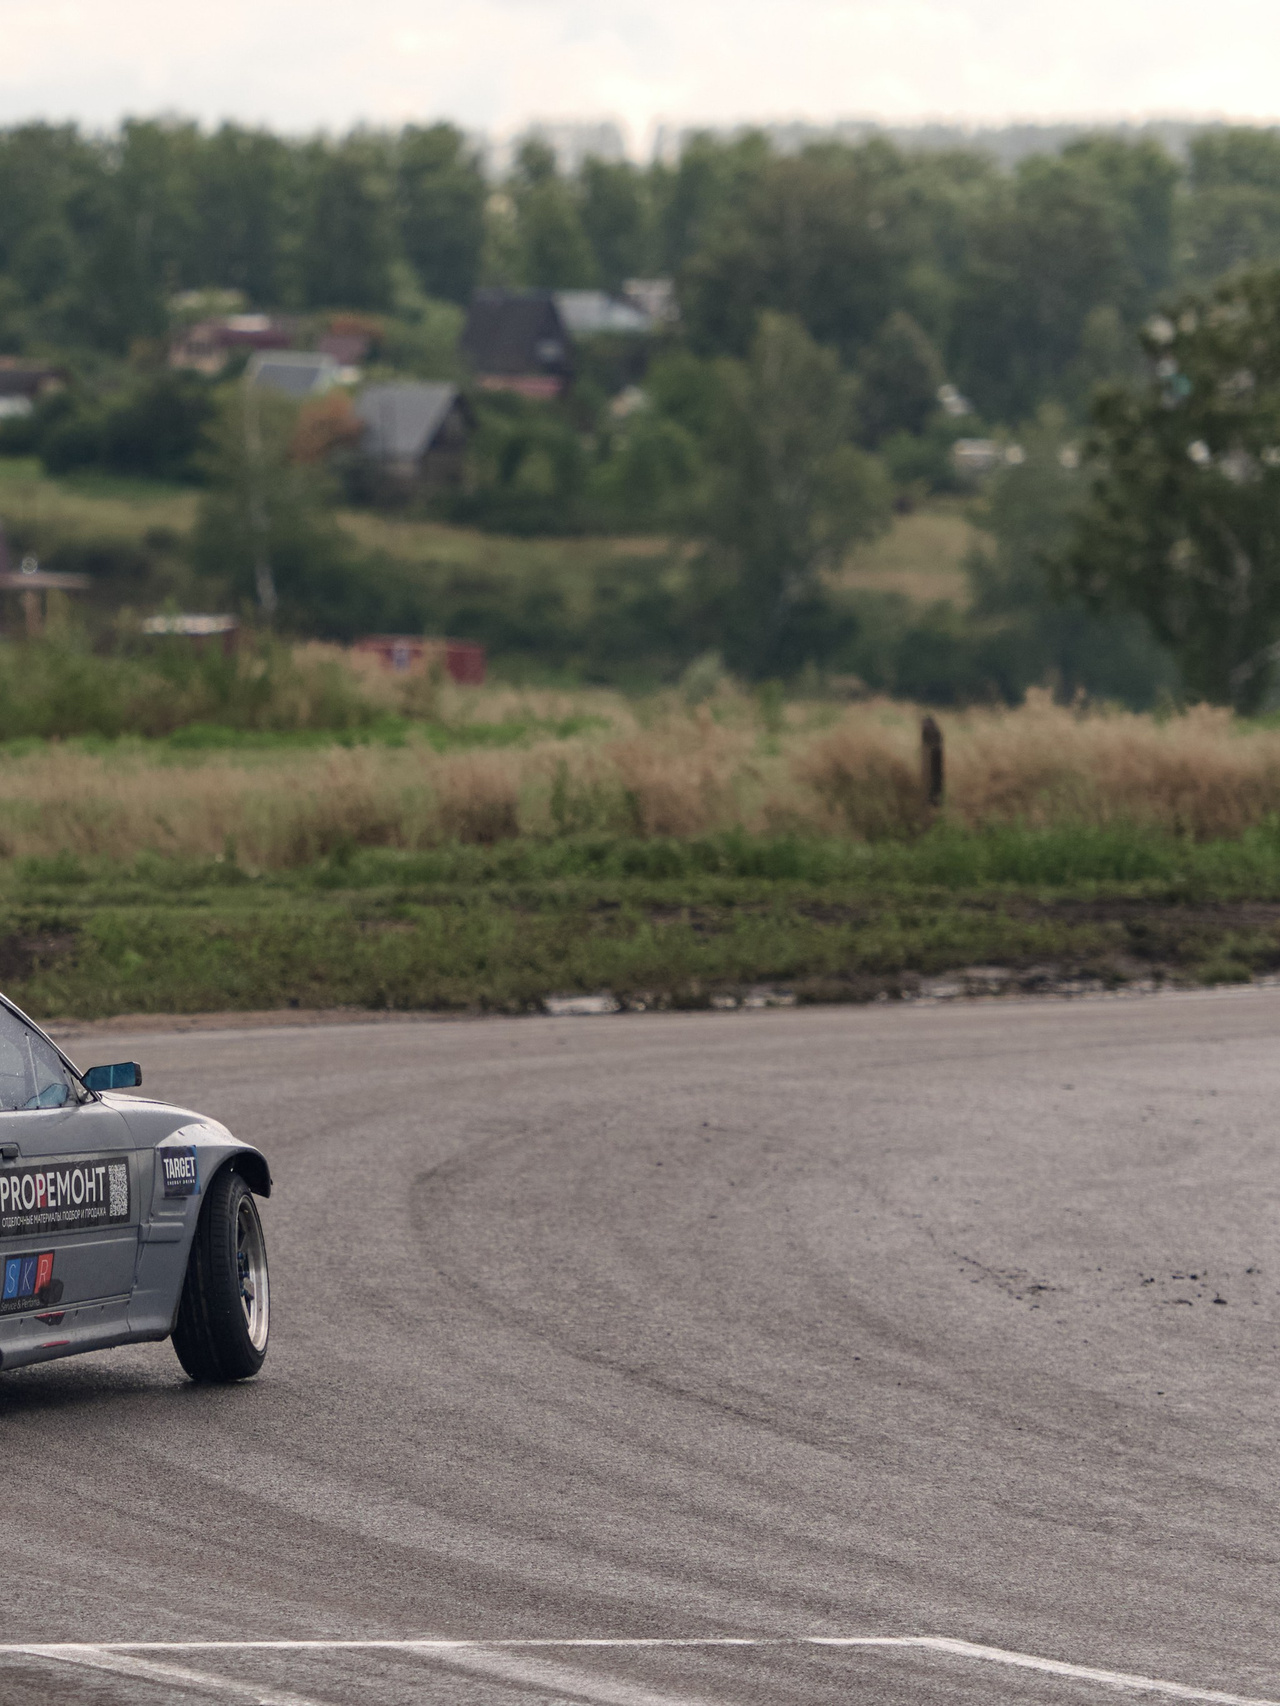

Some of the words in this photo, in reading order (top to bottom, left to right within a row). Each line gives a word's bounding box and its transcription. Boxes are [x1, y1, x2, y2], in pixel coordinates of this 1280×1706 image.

[163, 1156, 195, 1179] TARGET
[0, 1166, 106, 1212] PROРЕМОНТ
[1, 1214, 33, 1228] ОТДЕЛОЧНЫЕ
[62, 1209, 80, 1221] ПОДБОР
[80, 1209, 85, 1218] И
[85, 1207, 106, 1218] ПРОДАЖА
[7, 1259, 49, 1293] SKR
[0, 1301, 17, 1312] Service
[17, 1299, 22, 1310] &
